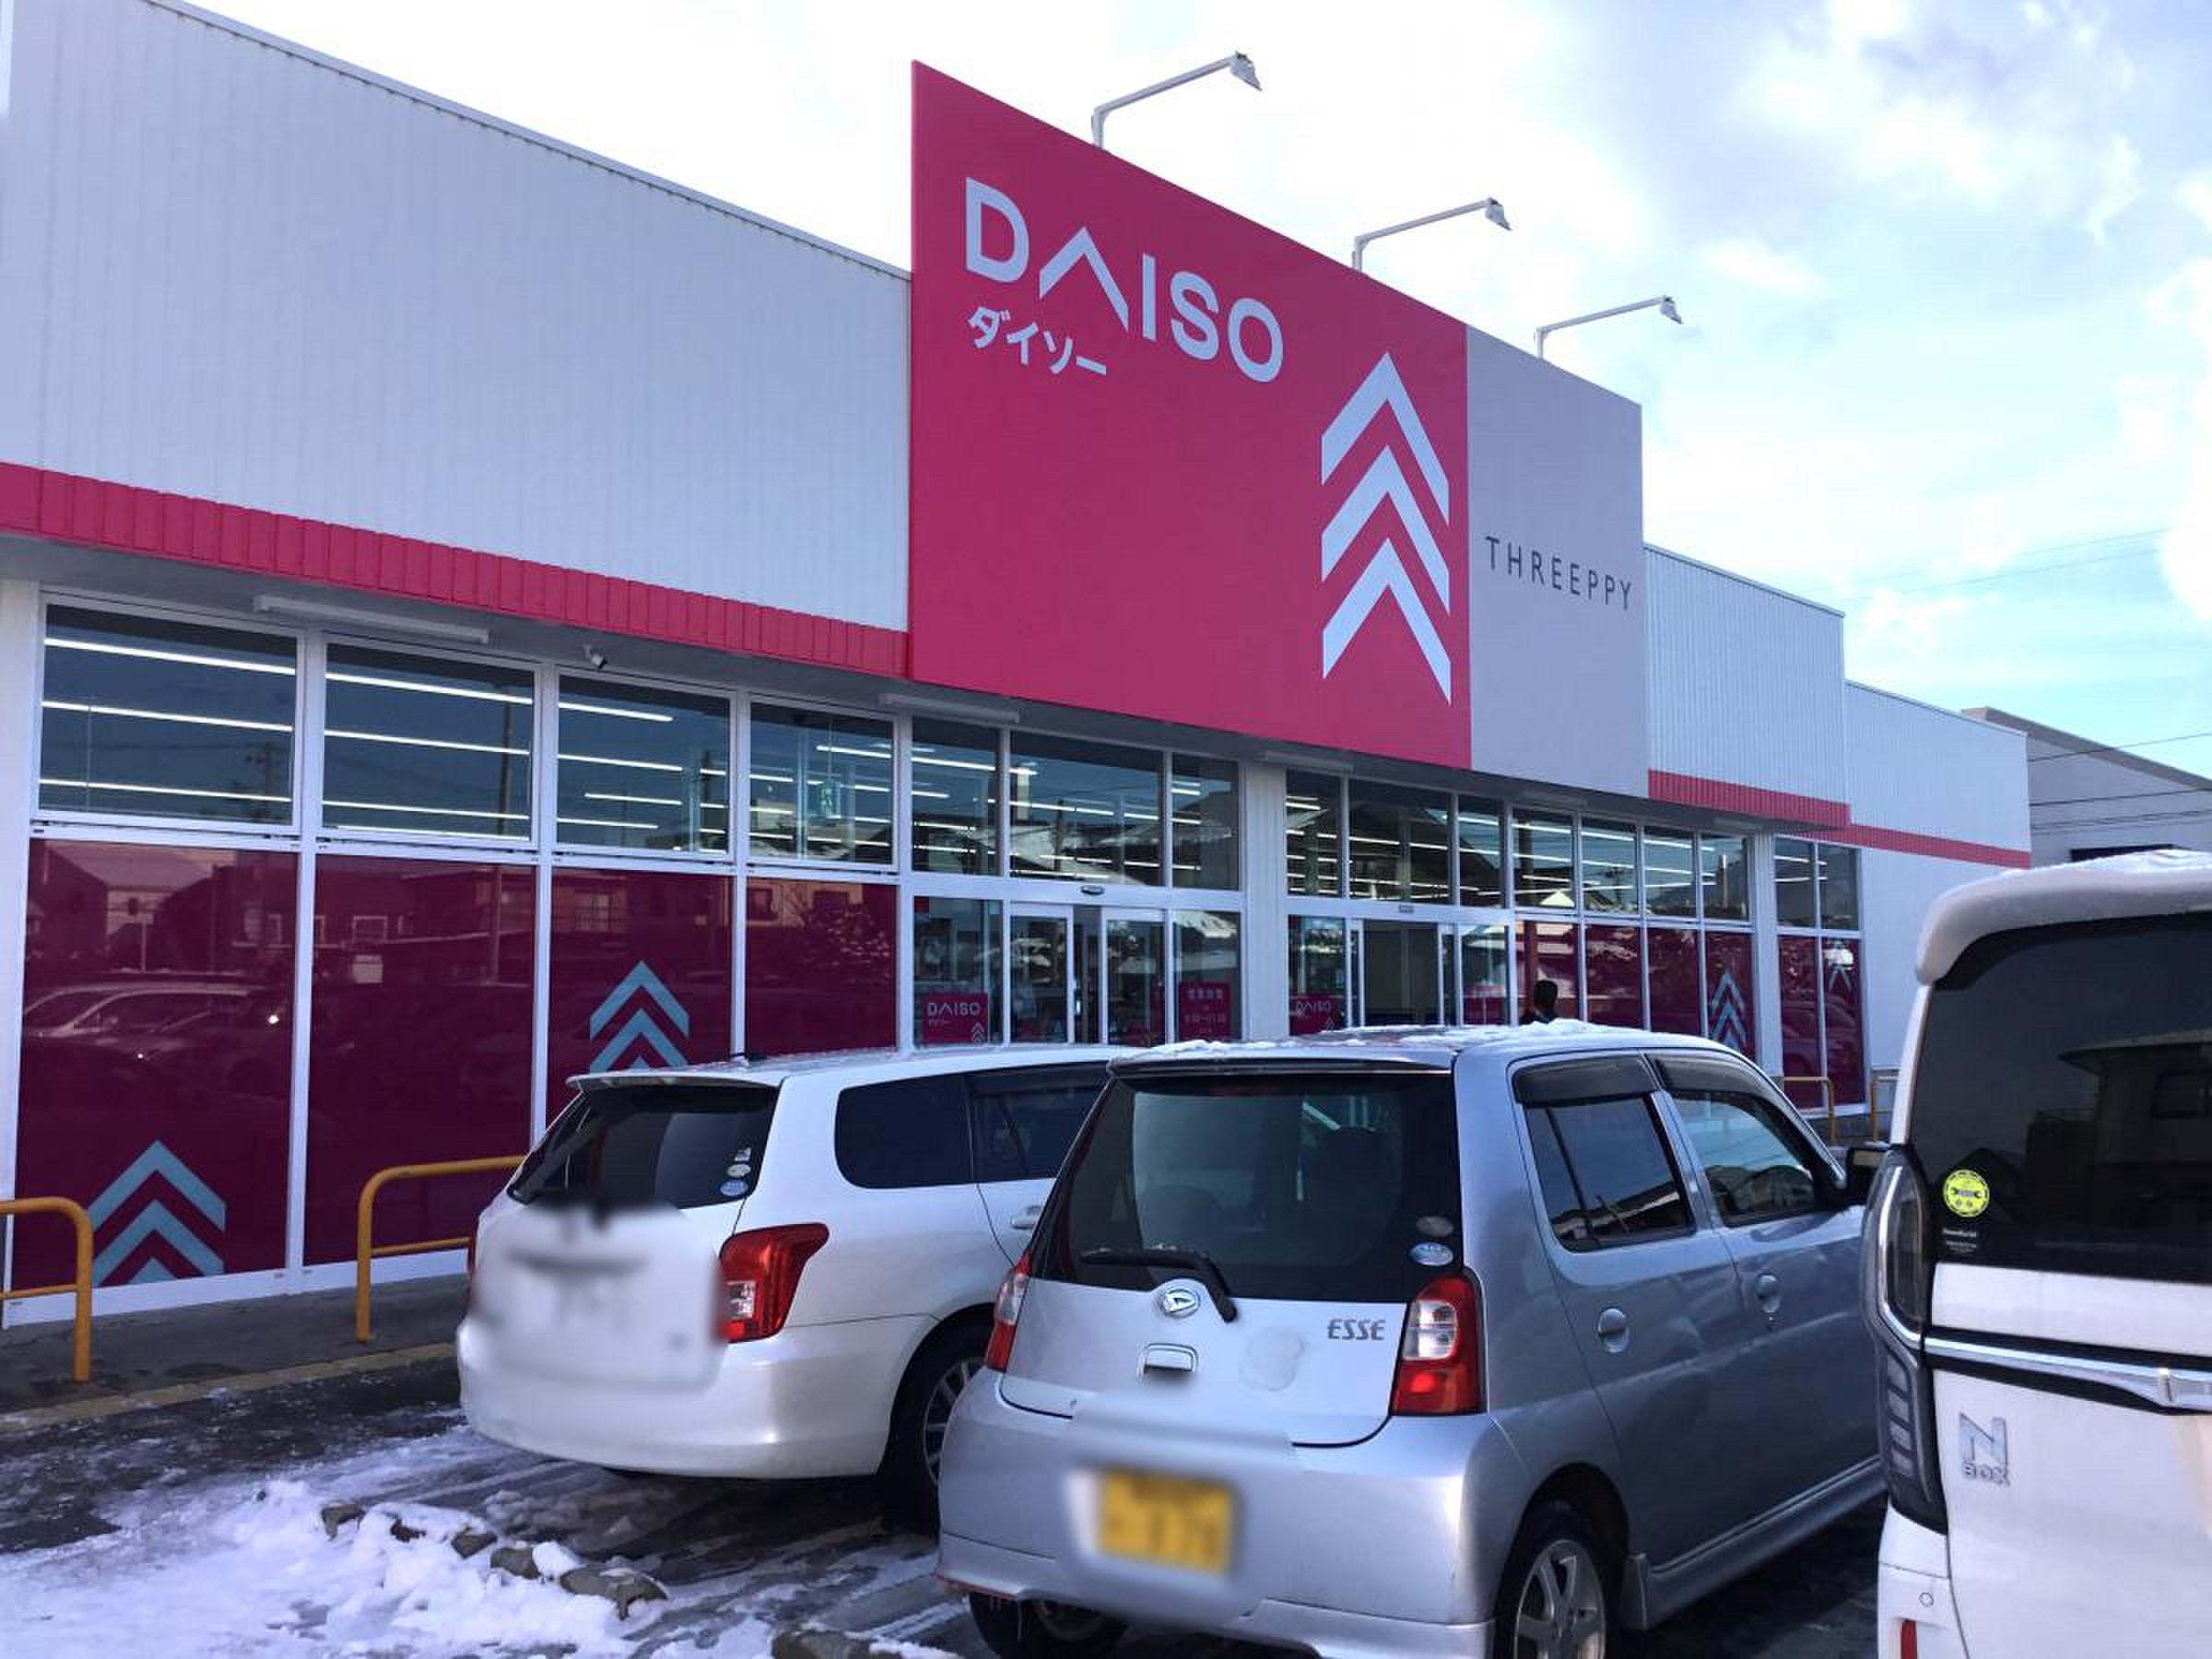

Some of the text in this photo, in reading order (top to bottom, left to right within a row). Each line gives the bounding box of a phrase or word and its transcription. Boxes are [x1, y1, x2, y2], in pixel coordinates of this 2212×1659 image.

[965, 177, 1284, 382] DAISO
[968, 306, 1107, 375] ダイソー
[1485, 535, 1631, 611] THREEPPY
[927, 1002, 981, 1017] DAISO
[1327, 1319, 1386, 1340] ESSE
[1959, 1412, 2007, 1465] N
